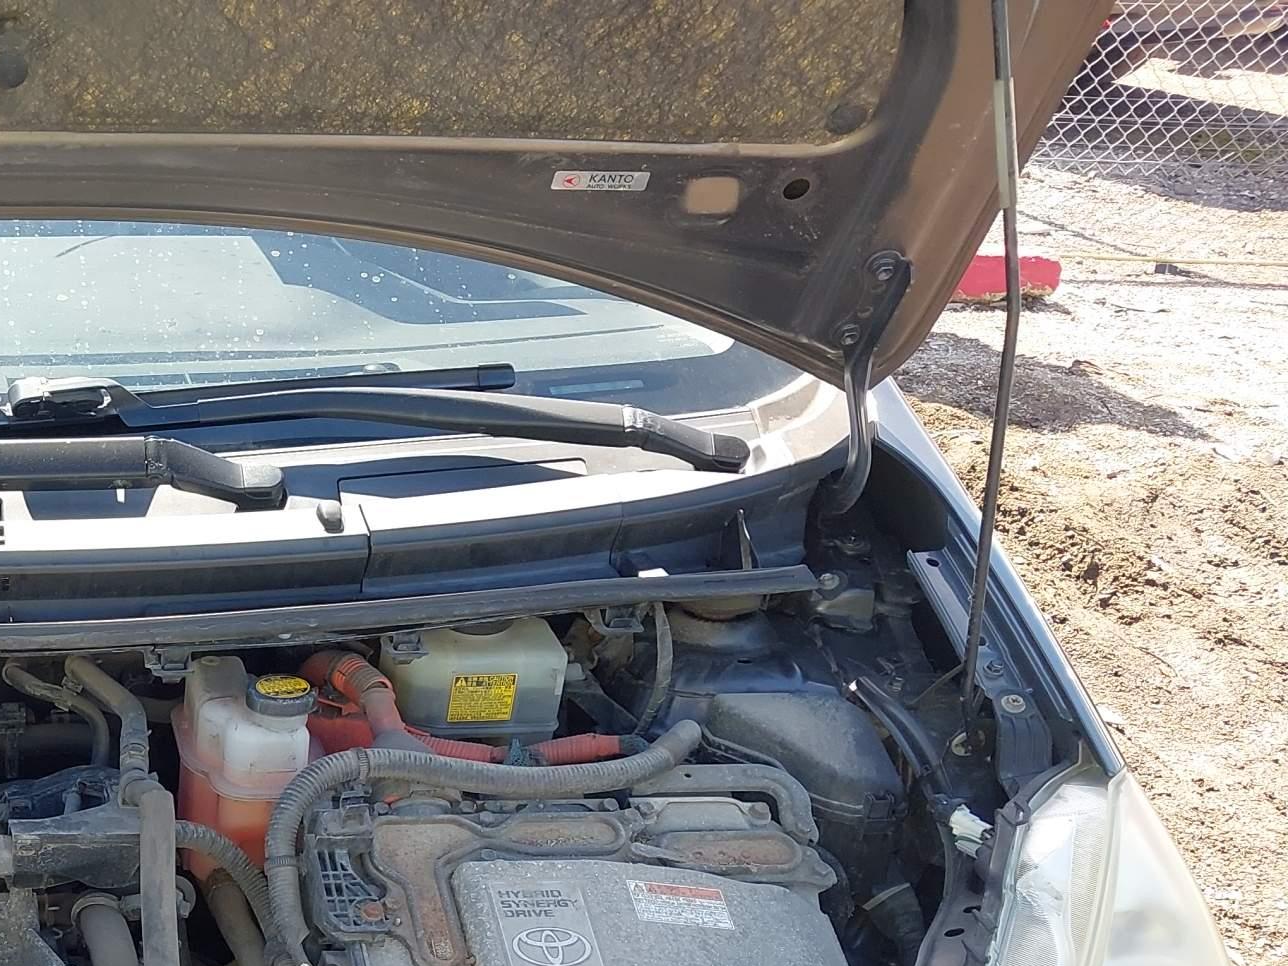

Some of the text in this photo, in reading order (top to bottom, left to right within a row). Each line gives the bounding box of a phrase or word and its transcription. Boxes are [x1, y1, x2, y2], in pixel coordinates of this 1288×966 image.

[588, 174, 634, 183] KANTO
[497, 889, 562, 898] HYBRID
[500, 899, 578, 908] SYNERGY
[503, 909, 556, 918] DRIVE
